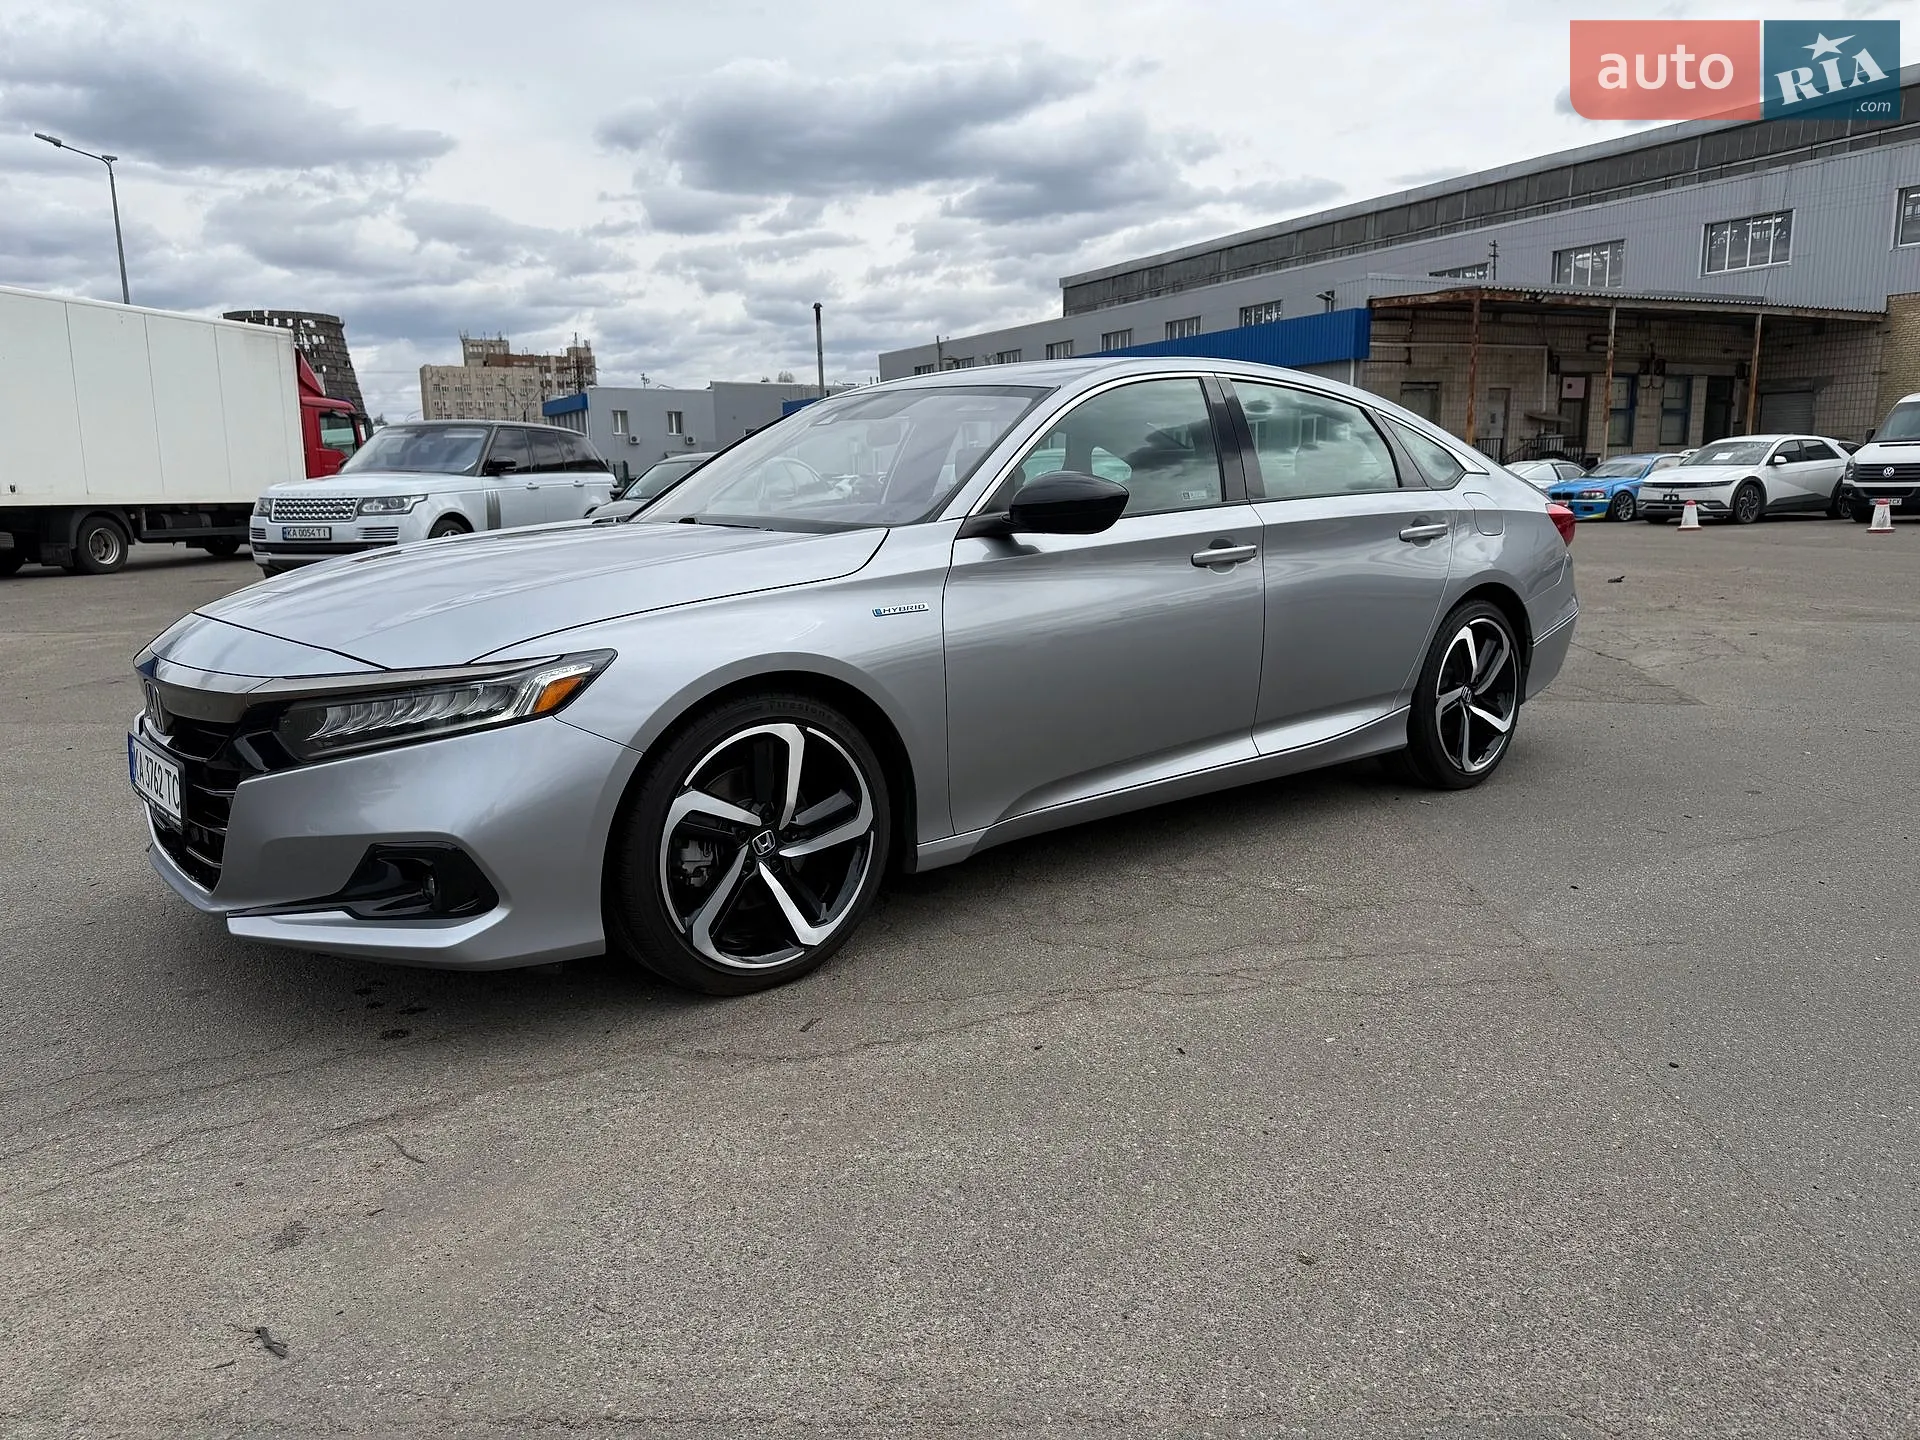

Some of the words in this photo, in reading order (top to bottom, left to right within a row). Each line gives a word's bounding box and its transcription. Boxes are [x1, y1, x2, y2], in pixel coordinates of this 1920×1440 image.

[882, 603, 926, 614] HYBRID
[145, 754, 164, 800] 3762
[165, 768, 180, 810] TC
